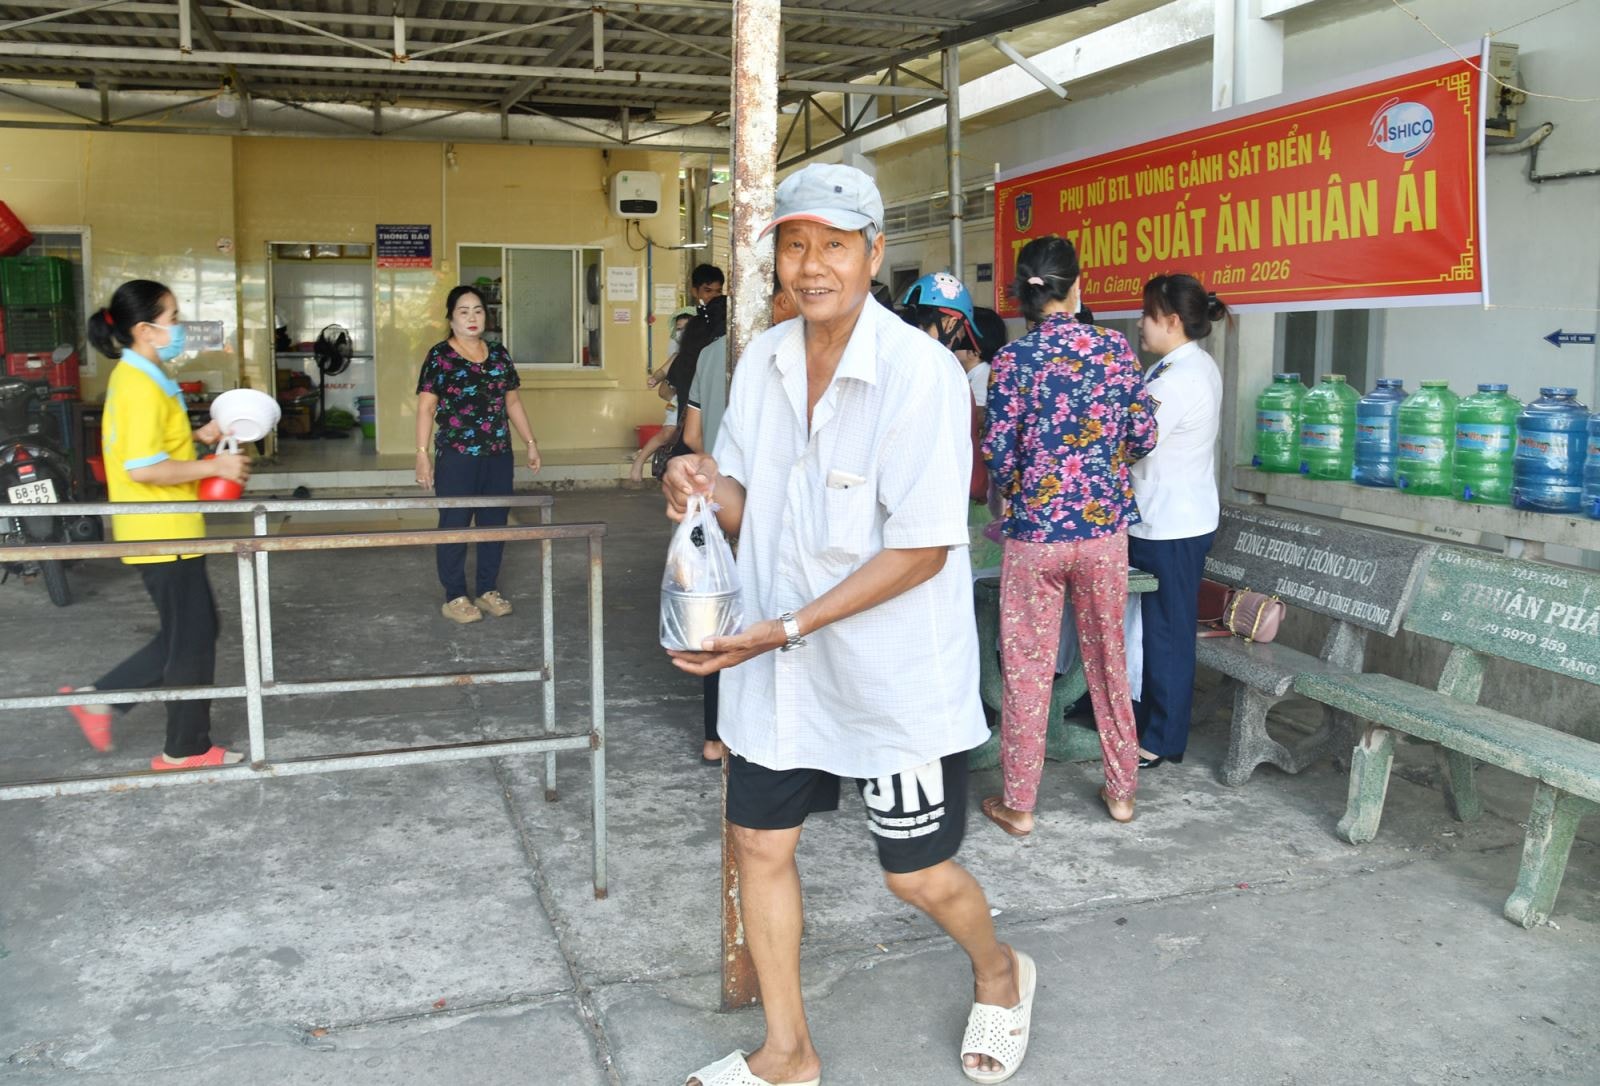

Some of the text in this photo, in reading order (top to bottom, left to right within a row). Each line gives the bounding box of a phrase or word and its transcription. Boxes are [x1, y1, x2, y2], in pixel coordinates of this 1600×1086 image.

[1368, 115, 1433, 146] ASHICO
[1060, 124, 1331, 214] PHỤ NỮ BTL VÙNG CẢNH SÁT BIỂN 4
[1136, 193, 1206, 263] SUẤT
[1216, 193, 1260, 254] ĂN
[1271, 173, 1379, 247] NHÂN
[1393, 160, 1437, 234] ÁI
[1085, 278, 1100, 294] An
[1104, 275, 1144, 296] Giang,
[1212, 264, 1246, 285] năm
[1250, 259, 1291, 283] 2026
[1501, 627, 1537, 645] 5979
[1539, 637, 1567, 653] 259
